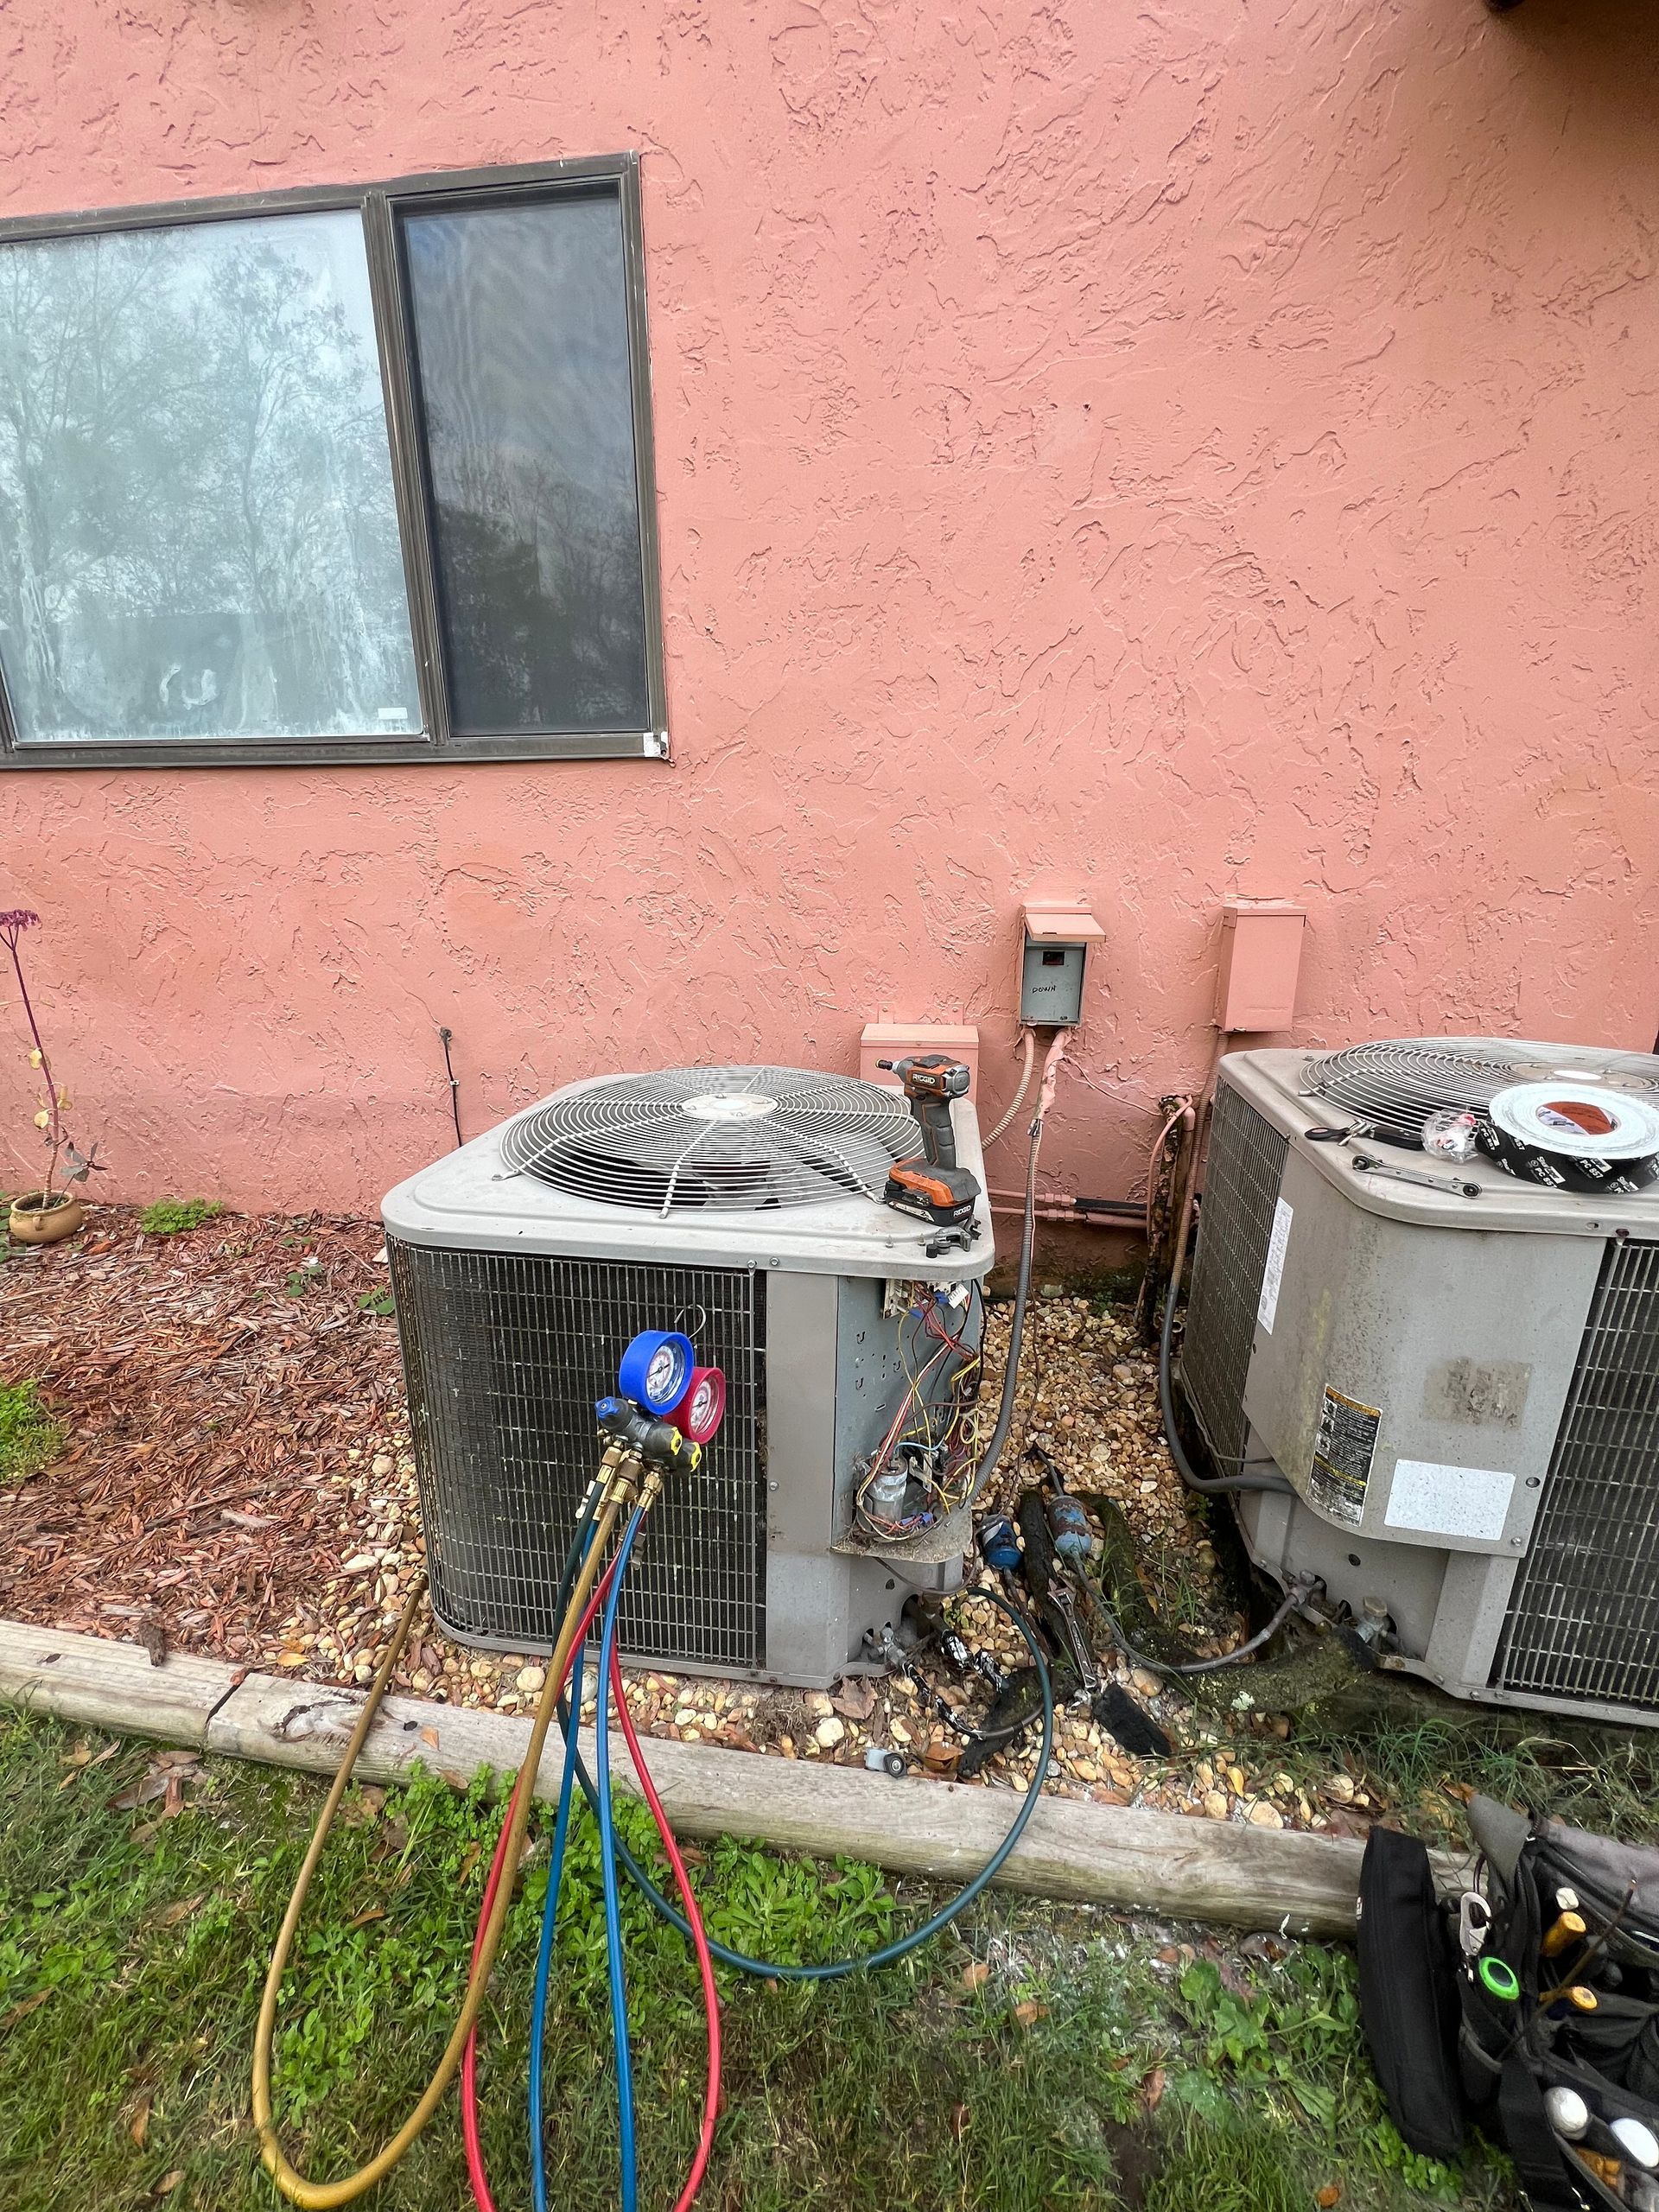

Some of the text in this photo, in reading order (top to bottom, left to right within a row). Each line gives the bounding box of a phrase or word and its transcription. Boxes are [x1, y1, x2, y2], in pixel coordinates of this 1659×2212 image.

[1032, 985, 1056, 994] DOWN
[912, 1073, 936, 1084] RIDGID
[1535, 1167, 1546, 1177] PC
[1580, 1160, 1592, 1169] PC
[1589, 1167, 1604, 1179] 857
